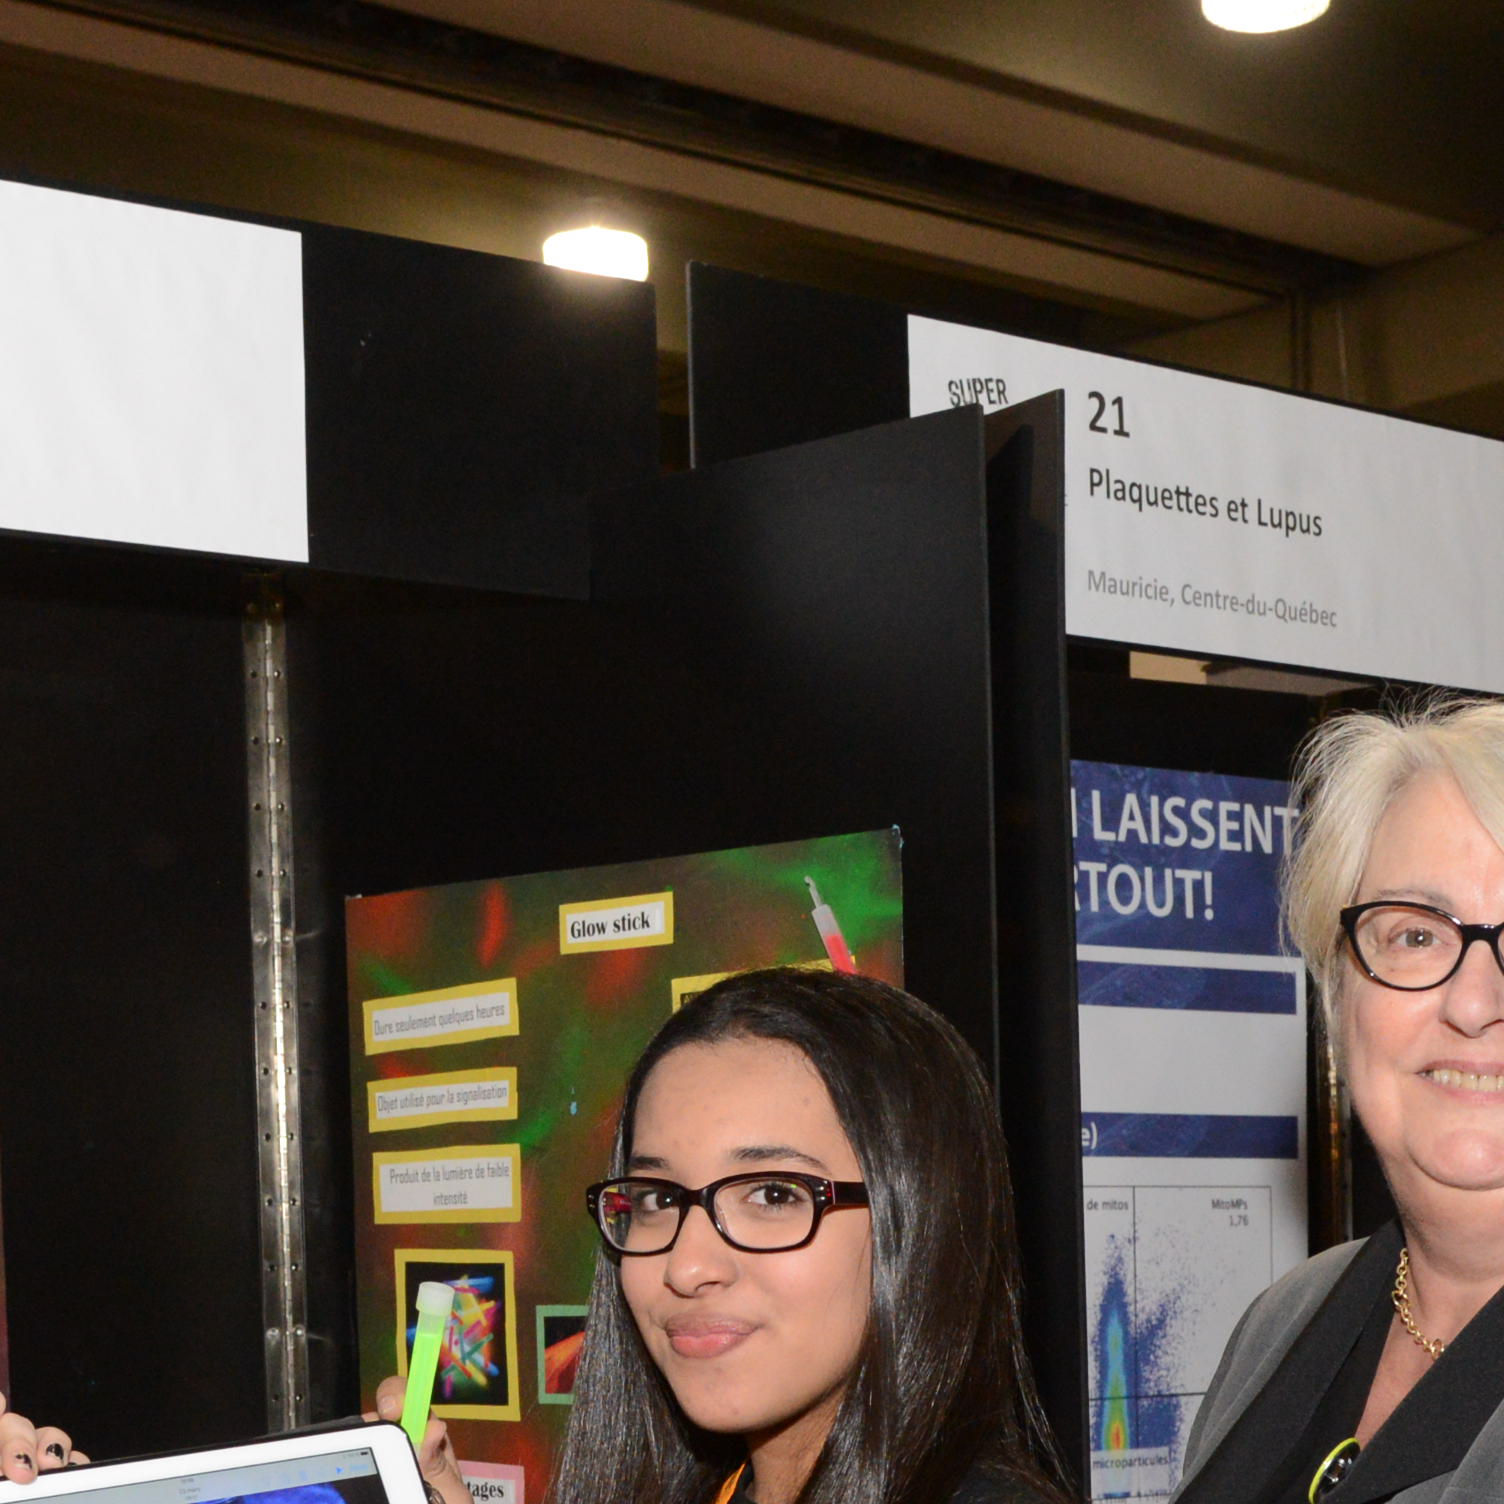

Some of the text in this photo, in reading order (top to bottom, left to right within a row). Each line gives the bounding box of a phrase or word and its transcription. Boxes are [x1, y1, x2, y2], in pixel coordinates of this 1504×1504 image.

[947, 377, 1009, 407] SUPER
[1088, 391, 1131, 438] 21
[1088, 467, 1324, 540] Plaquettes et Lupus
[1088, 569, 1338, 628] Mauricie, Centre-du-Québec
[1092, 789, 1300, 856] LAISSENT
[570, 911, 651, 940] Glow stick
[476, 1003, 506, 1020] heures
[1102, 1199, 1129, 1211] mitos
[1093, 1454, 1169, 1469] microparticules
